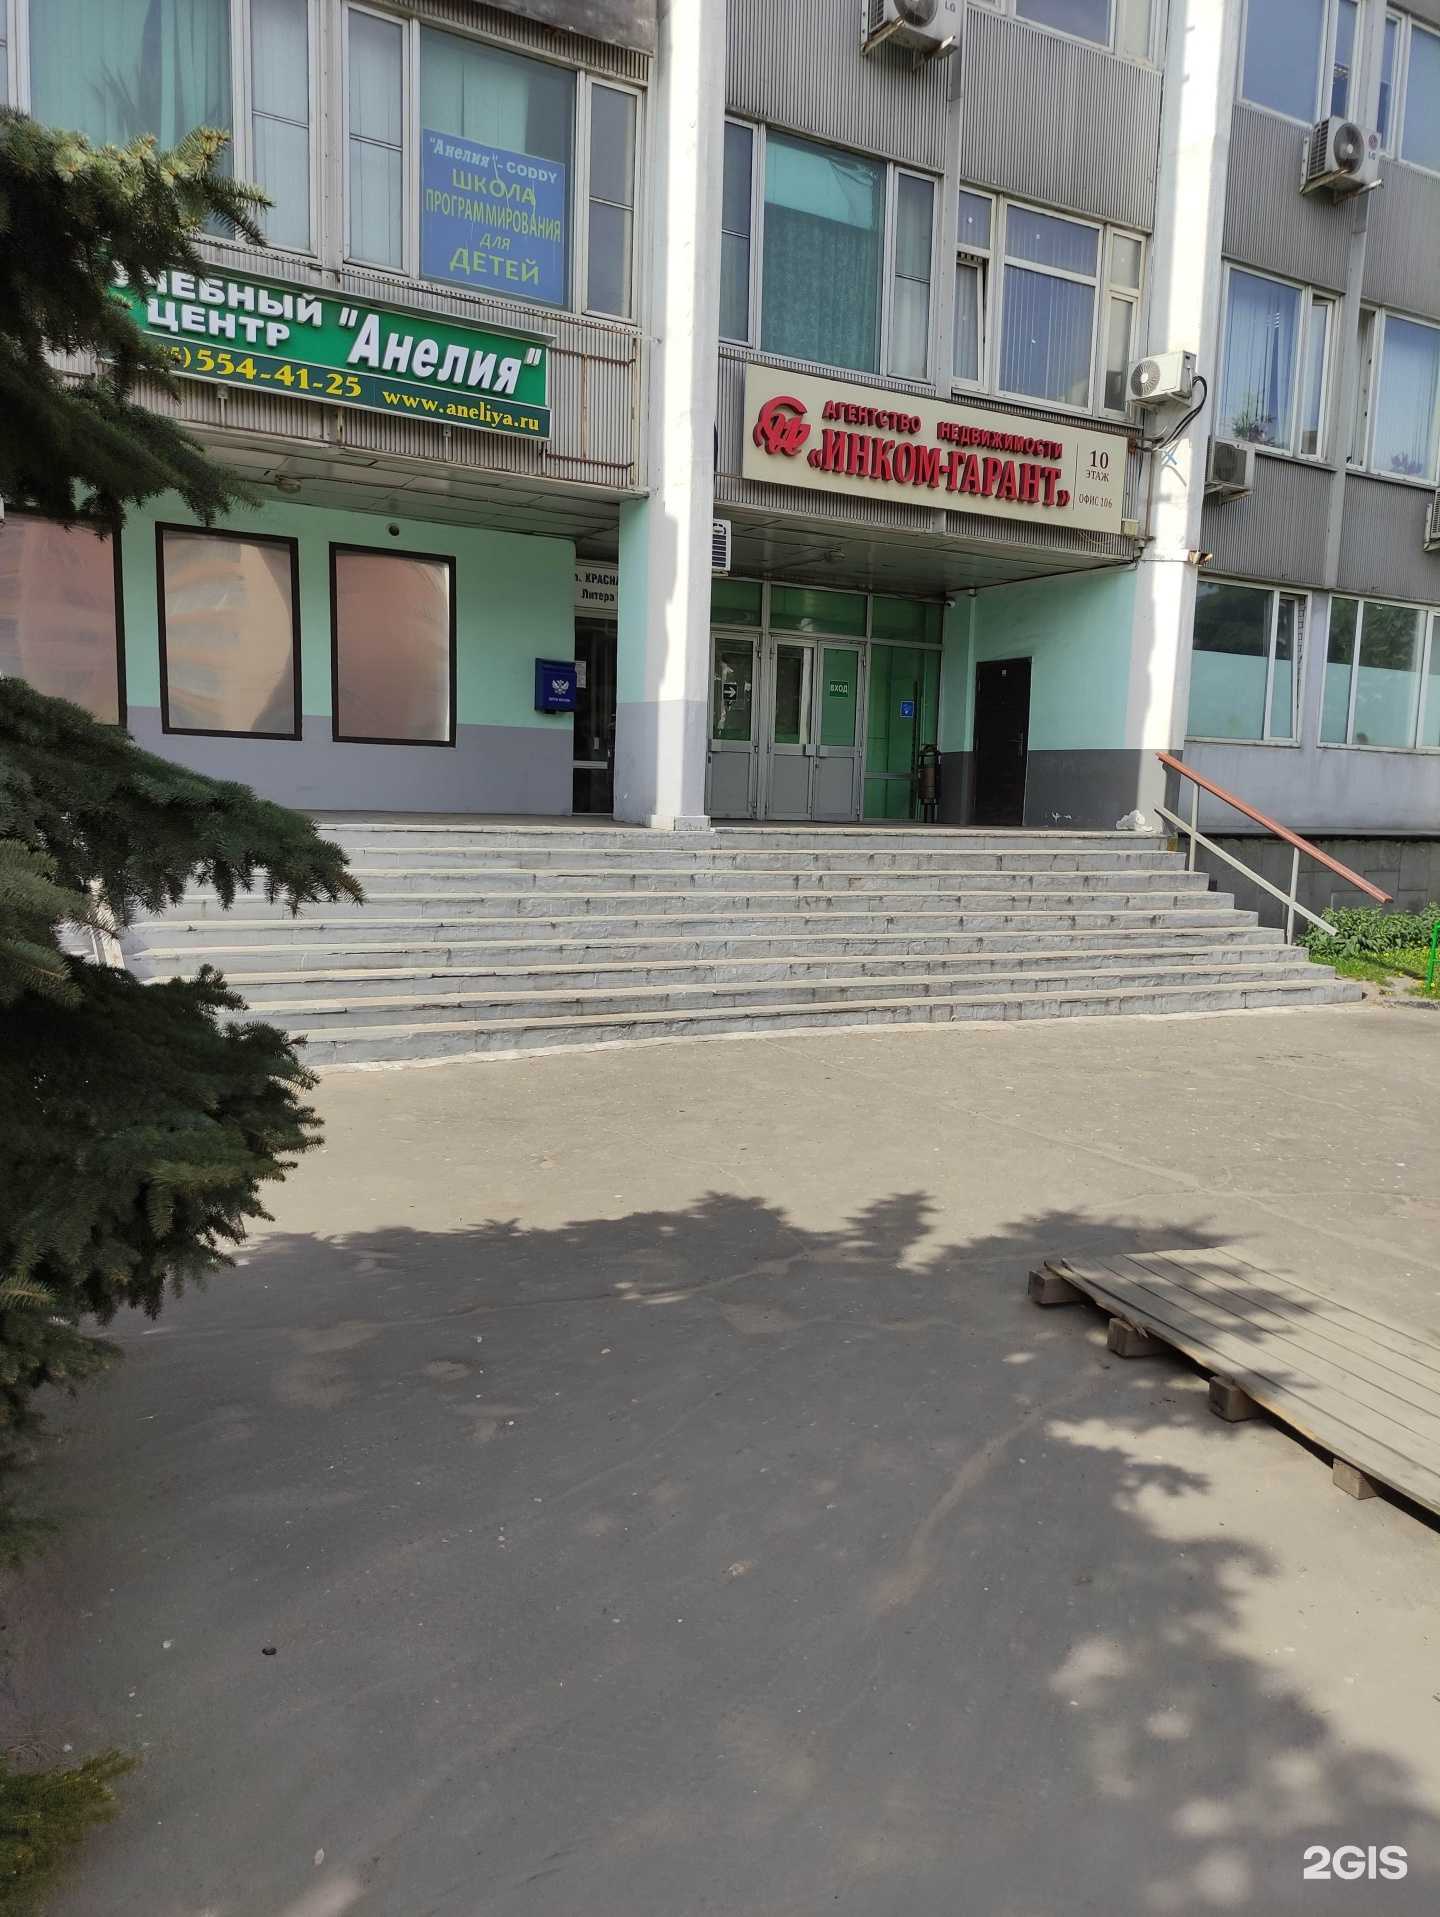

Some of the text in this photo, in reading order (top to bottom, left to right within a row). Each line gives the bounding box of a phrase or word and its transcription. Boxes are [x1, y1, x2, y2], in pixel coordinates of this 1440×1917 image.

[452, 168, 536, 206] ШКОЛА
[506, 161, 558, 184] CODDY
[425, 188, 561, 242] ПРОГРАММИРОВАНИЯ
[450, 247, 541, 286] ДЕТЕЙ
[147, 298, 290, 347] ЦЕНТР
[338, 307, 542, 395] "Анелия"
[382, 391, 540, 431] www.aneliya.ru
[821, 400, 1063, 461] АГЕНТСТВО НЕДВИЖИМОСТИ
[806, 428, 1071, 507] «ИНКОМ-ГАРАНТ»
[1087, 469, 1109, 482] ЭТАЖ
[1090, 450, 1109, 469] 10
[1079, 493, 1100, 506] ОФИС
[582, 588, 615, 603] Литера
[830, 684, 848, 693] ВХОД
